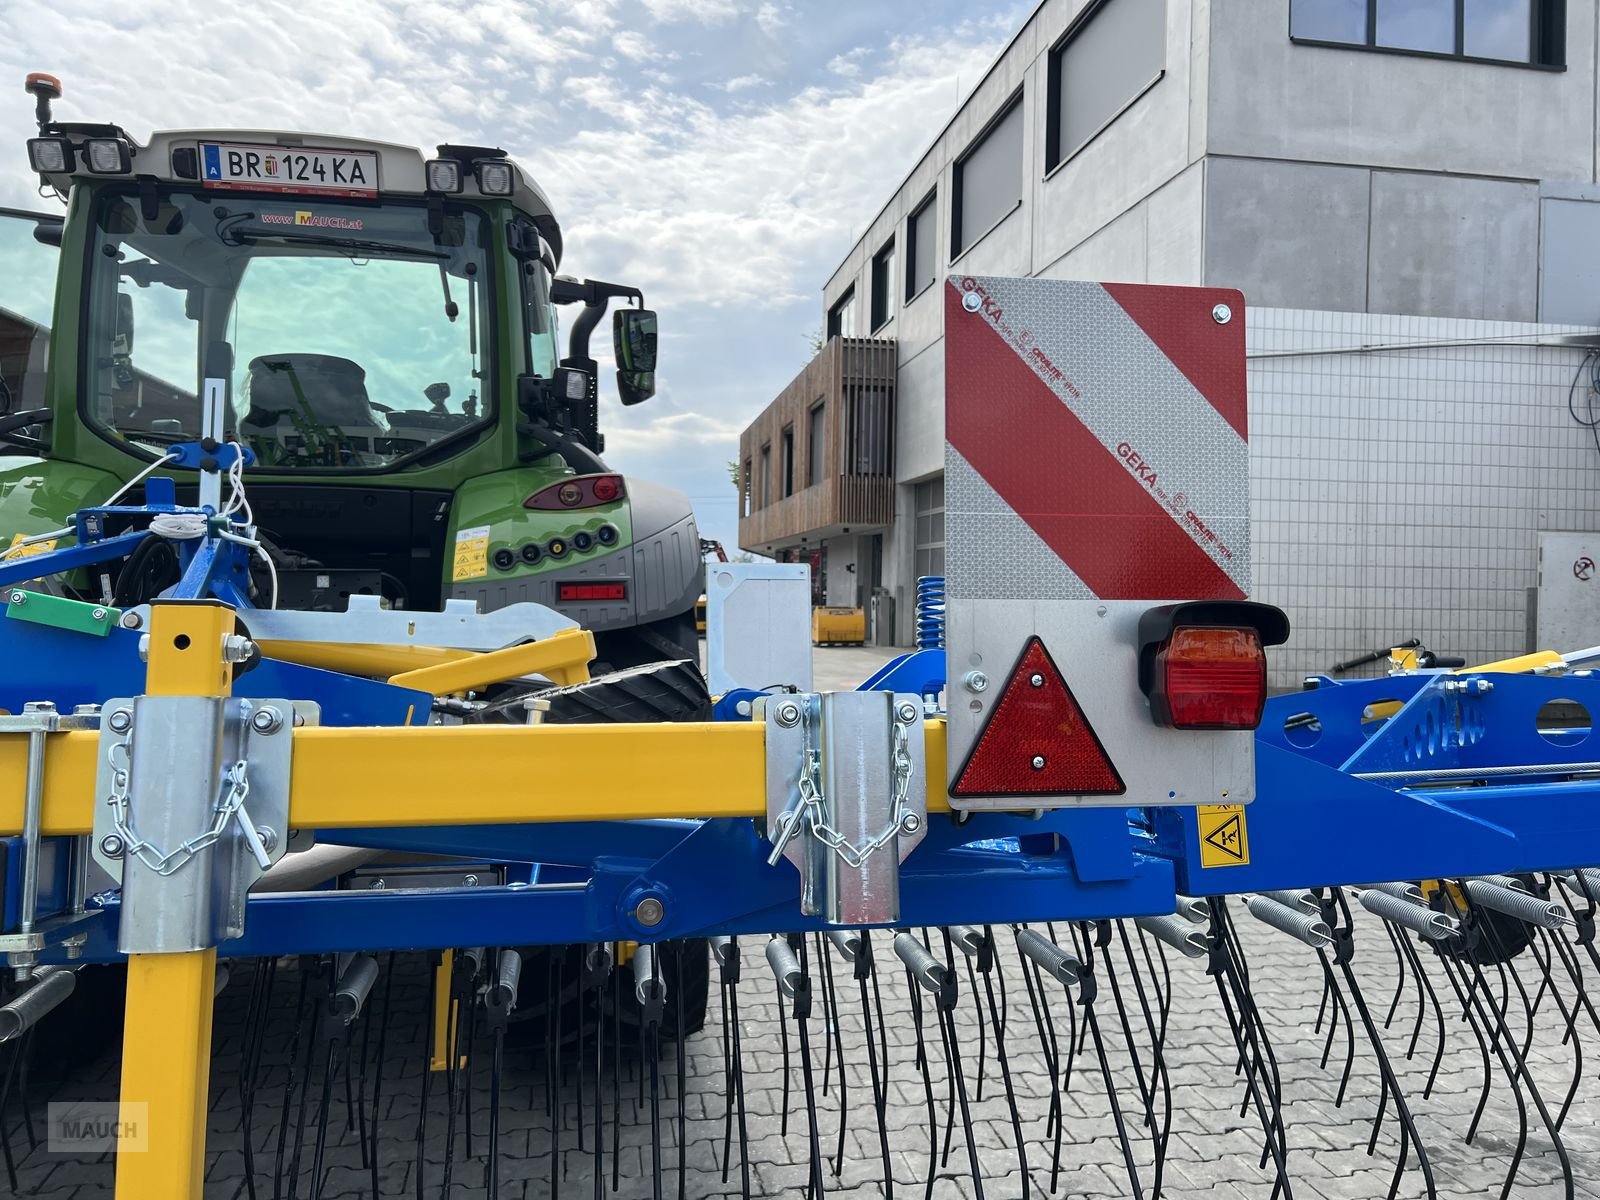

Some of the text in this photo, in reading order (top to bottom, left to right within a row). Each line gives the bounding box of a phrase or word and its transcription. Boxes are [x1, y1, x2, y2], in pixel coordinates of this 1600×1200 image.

[228, 151, 366, 184] BR 124 KA
[1117, 442, 1157, 488] GEKA
